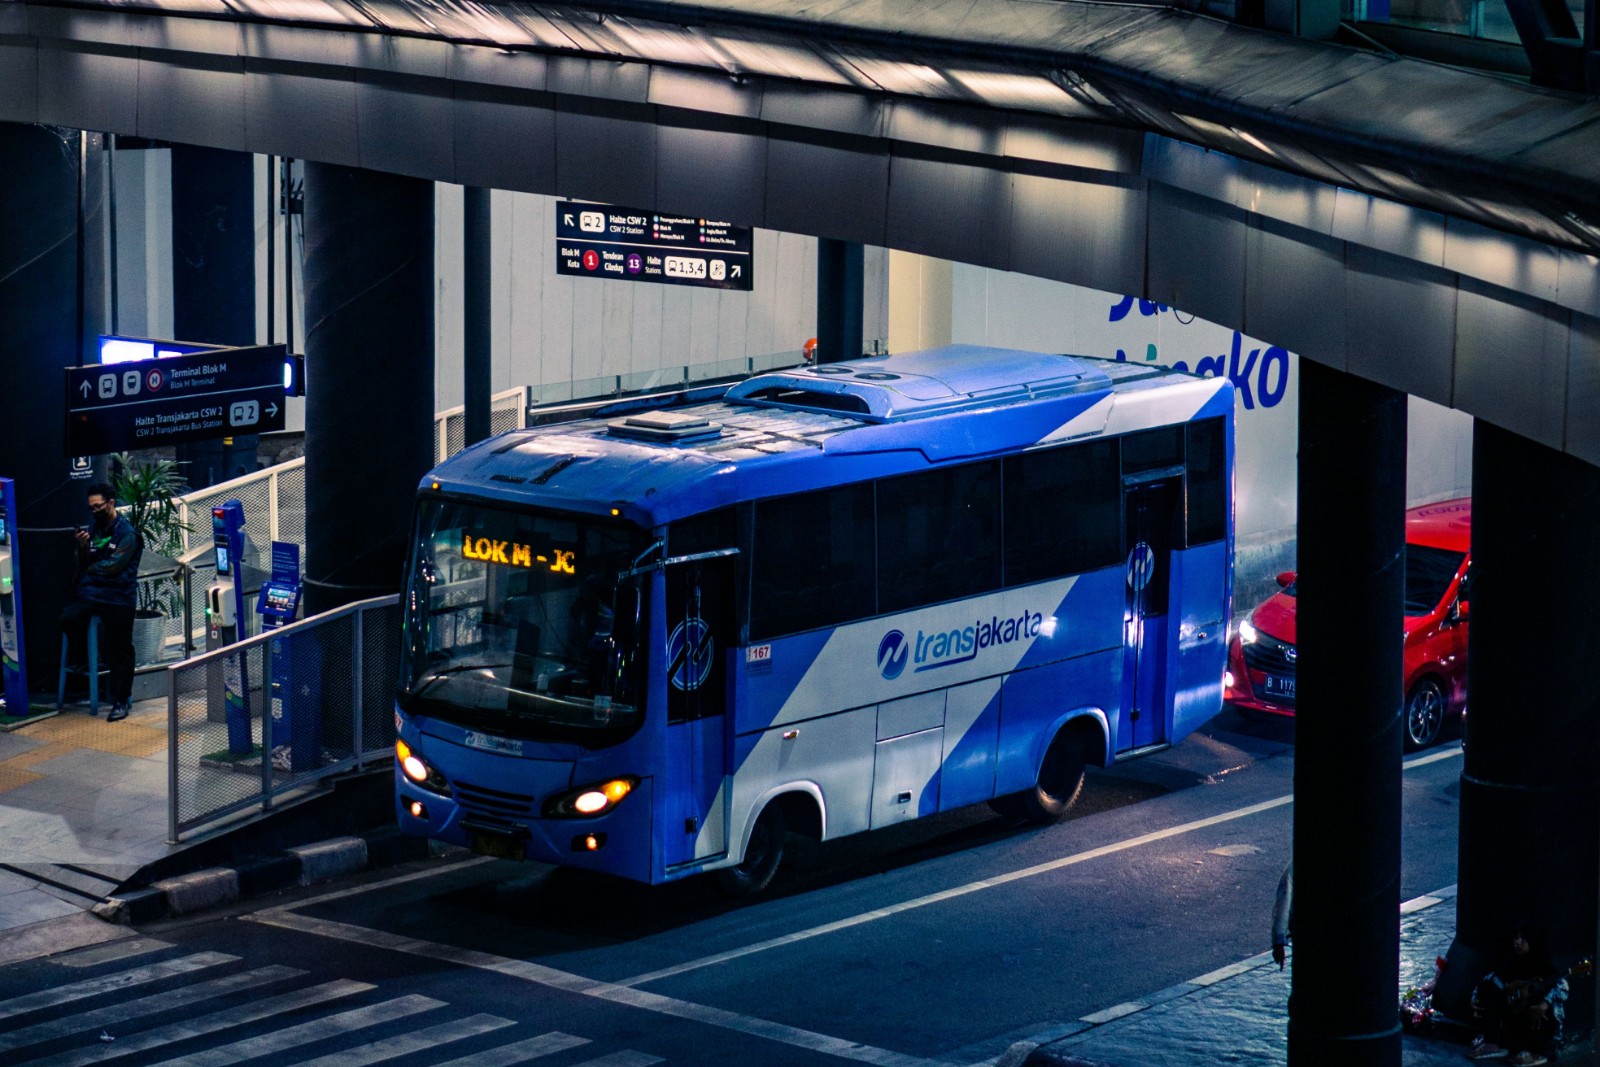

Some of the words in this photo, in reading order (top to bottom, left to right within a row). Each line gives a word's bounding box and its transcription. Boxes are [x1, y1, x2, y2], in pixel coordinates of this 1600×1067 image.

[596, 217, 600, 227] 2
[610, 215, 626, 224] Halte
[627, 216, 642, 225] CSW
[642, 217, 647, 226] 2
[562, 248, 573, 256] Blok
[602, 251, 624, 260] Tendean
[568, 260, 580, 268] Kota
[588, 255, 594, 266] 1
[629, 259, 640, 268] 13
[647, 256, 661, 265] Halte
[604, 263, 624, 274] Ciledug
[680, 262, 704, 275] 1,3,4
[171, 366, 200, 378] Terminal
[202, 364, 218, 374] Blok
[220, 363, 226, 372] M
[170, 381, 183, 389] Blok
[191, 377, 215, 386] Terminal
[136, 417, 154, 426] Halte
[156, 411, 199, 423] Transjakarta
[201, 407, 217, 418] CSW
[218, 407, 223, 416] 2
[248, 406, 254, 419] 2
[136, 428, 149, 437] CSW
[156, 424, 190, 434] Transjakarta
[203, 420, 223, 428] Station
[512, 542, 531, 567] M
[914, 609, 1042, 664] transjakarta
[754, 646, 769, 659] 167
[1268, 677, 1272, 688] B
